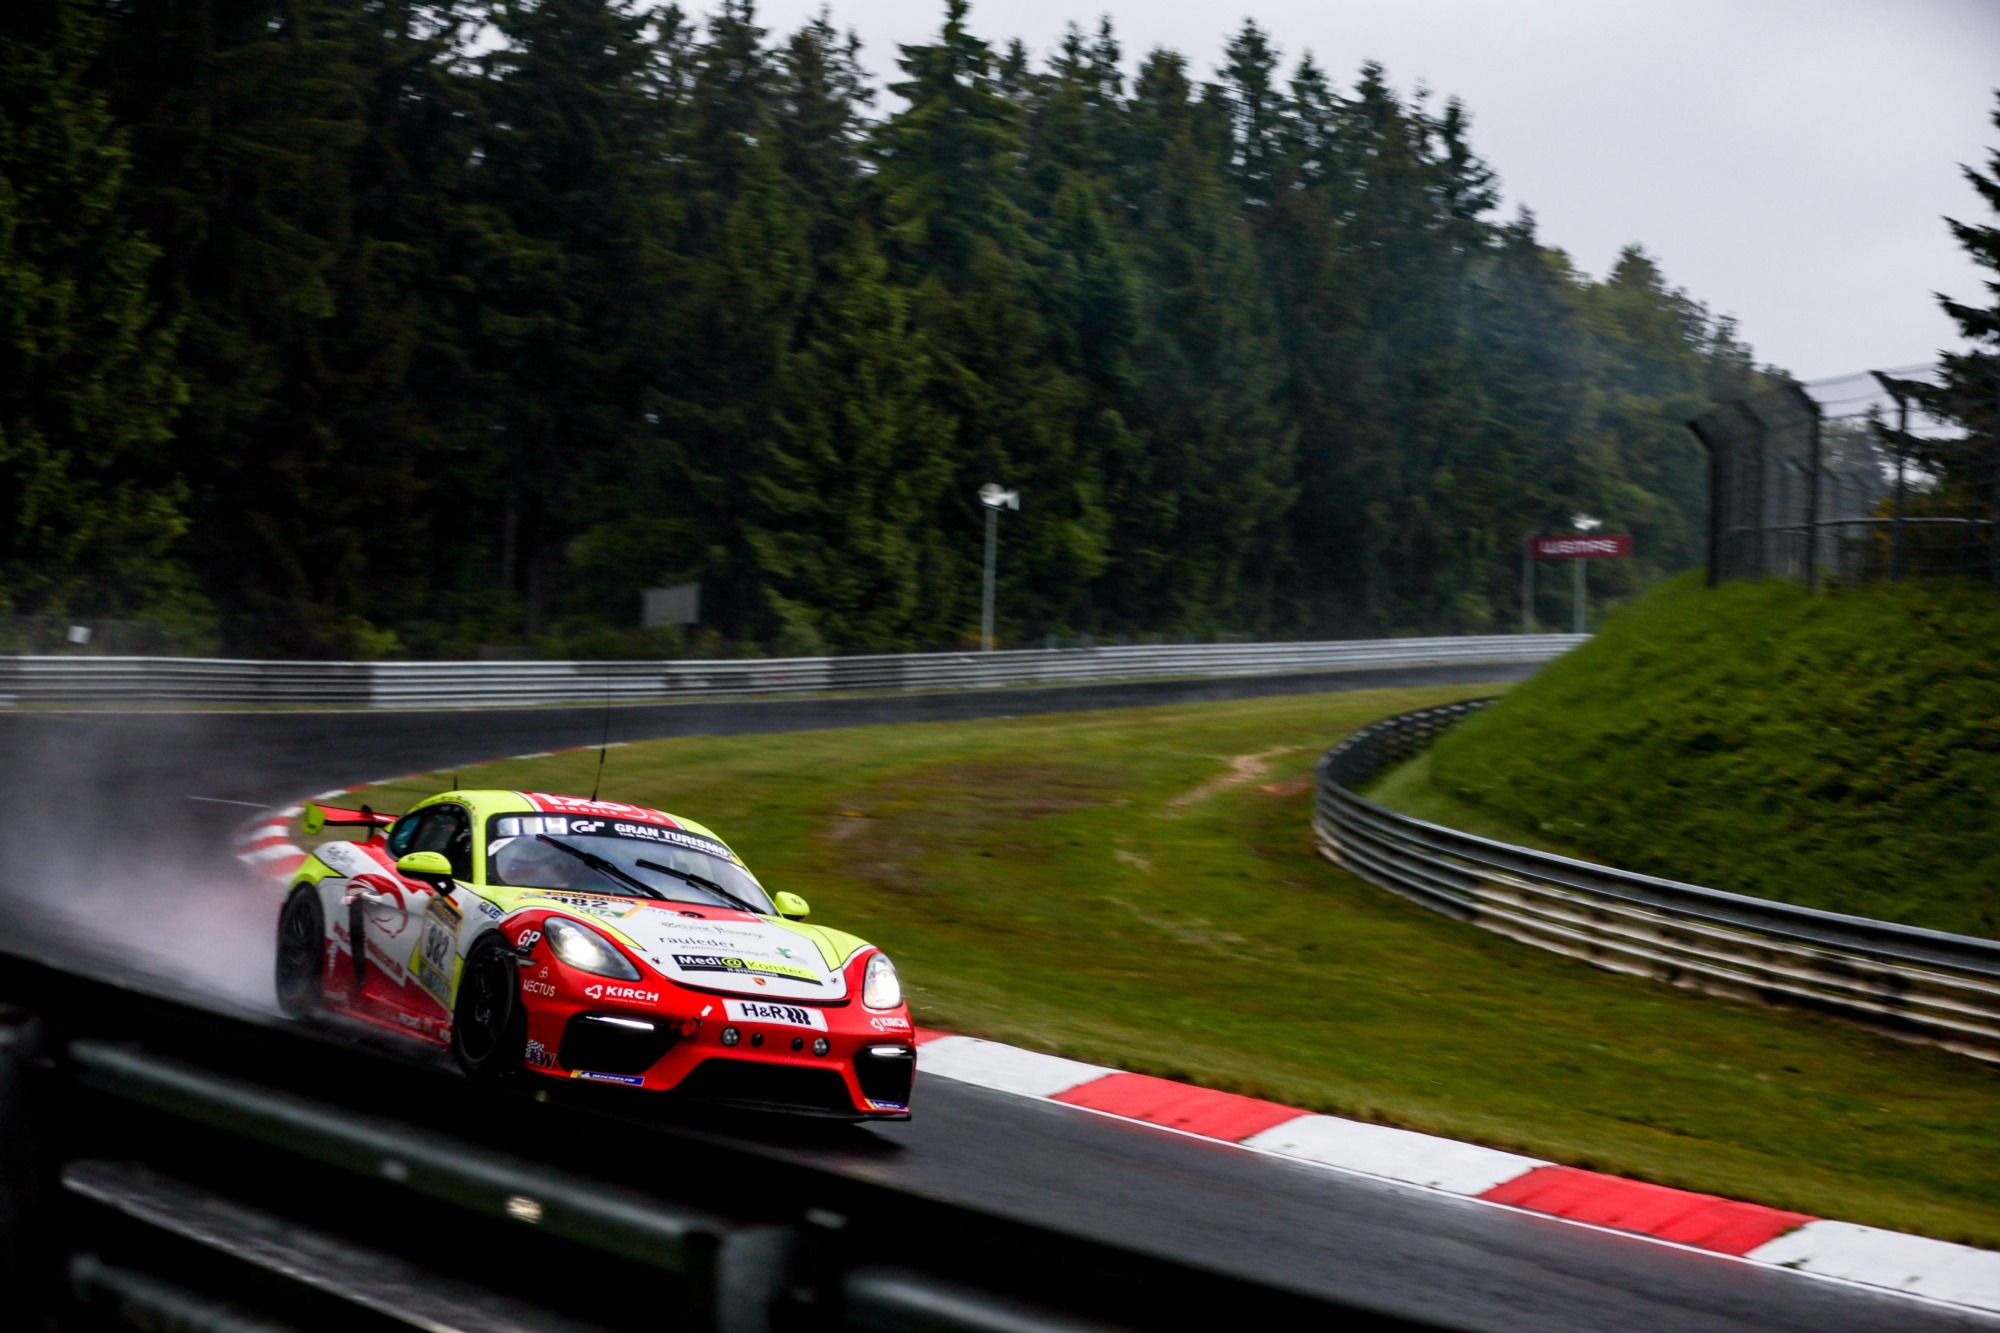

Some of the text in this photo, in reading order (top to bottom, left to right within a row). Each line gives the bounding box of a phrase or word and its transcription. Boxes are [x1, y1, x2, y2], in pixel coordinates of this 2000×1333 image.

[614, 823, 729, 856] GRAN TURISMO
[551, 896, 609, 909] 982
[517, 929, 542, 947] GP
[658, 937, 736, 949] rauleder
[605, 985, 659, 1002] KIRCH
[740, 1002, 785, 1020] H&R
[591, 1073, 636, 1083] MICHELIN
